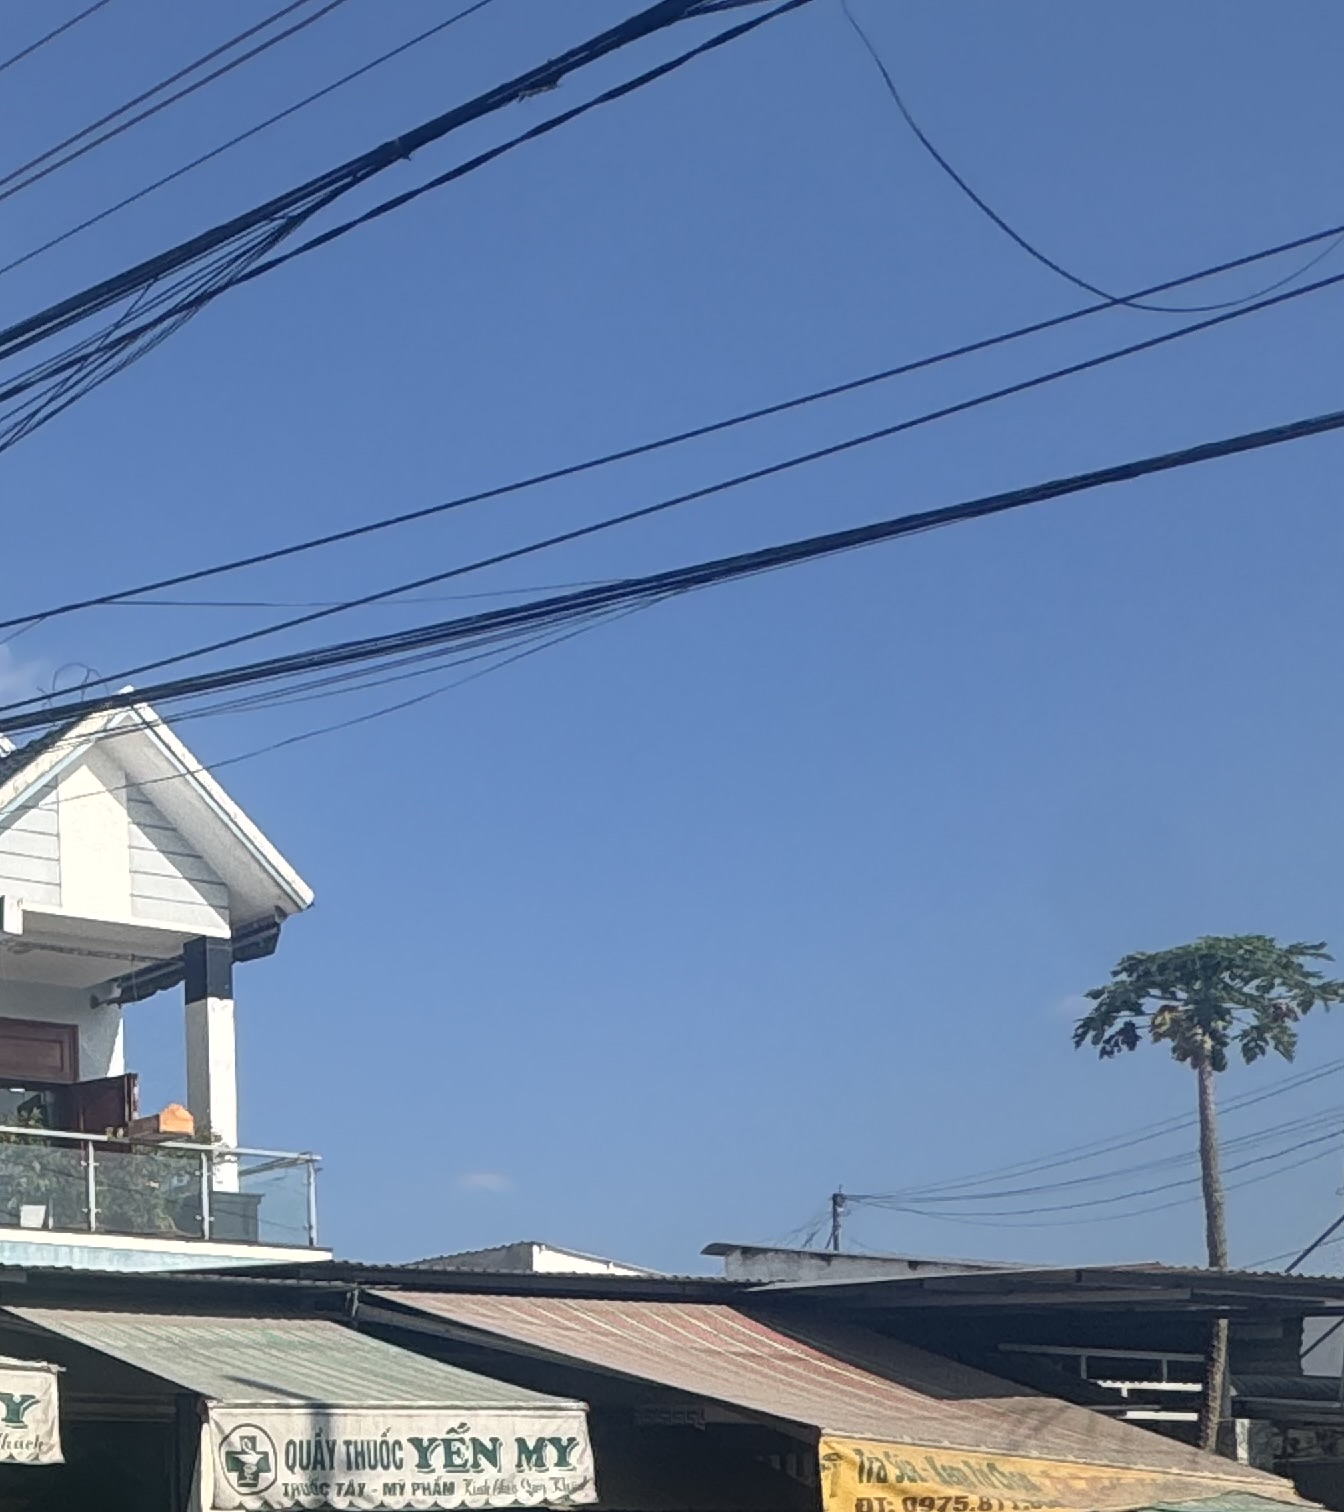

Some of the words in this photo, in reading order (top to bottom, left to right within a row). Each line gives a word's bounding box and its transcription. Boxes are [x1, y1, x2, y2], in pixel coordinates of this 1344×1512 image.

[342, 1427, 404, 1472] THUỐC
[407, 1422, 504, 1474] YẾN
[514, 1436, 580, 1474] MY
